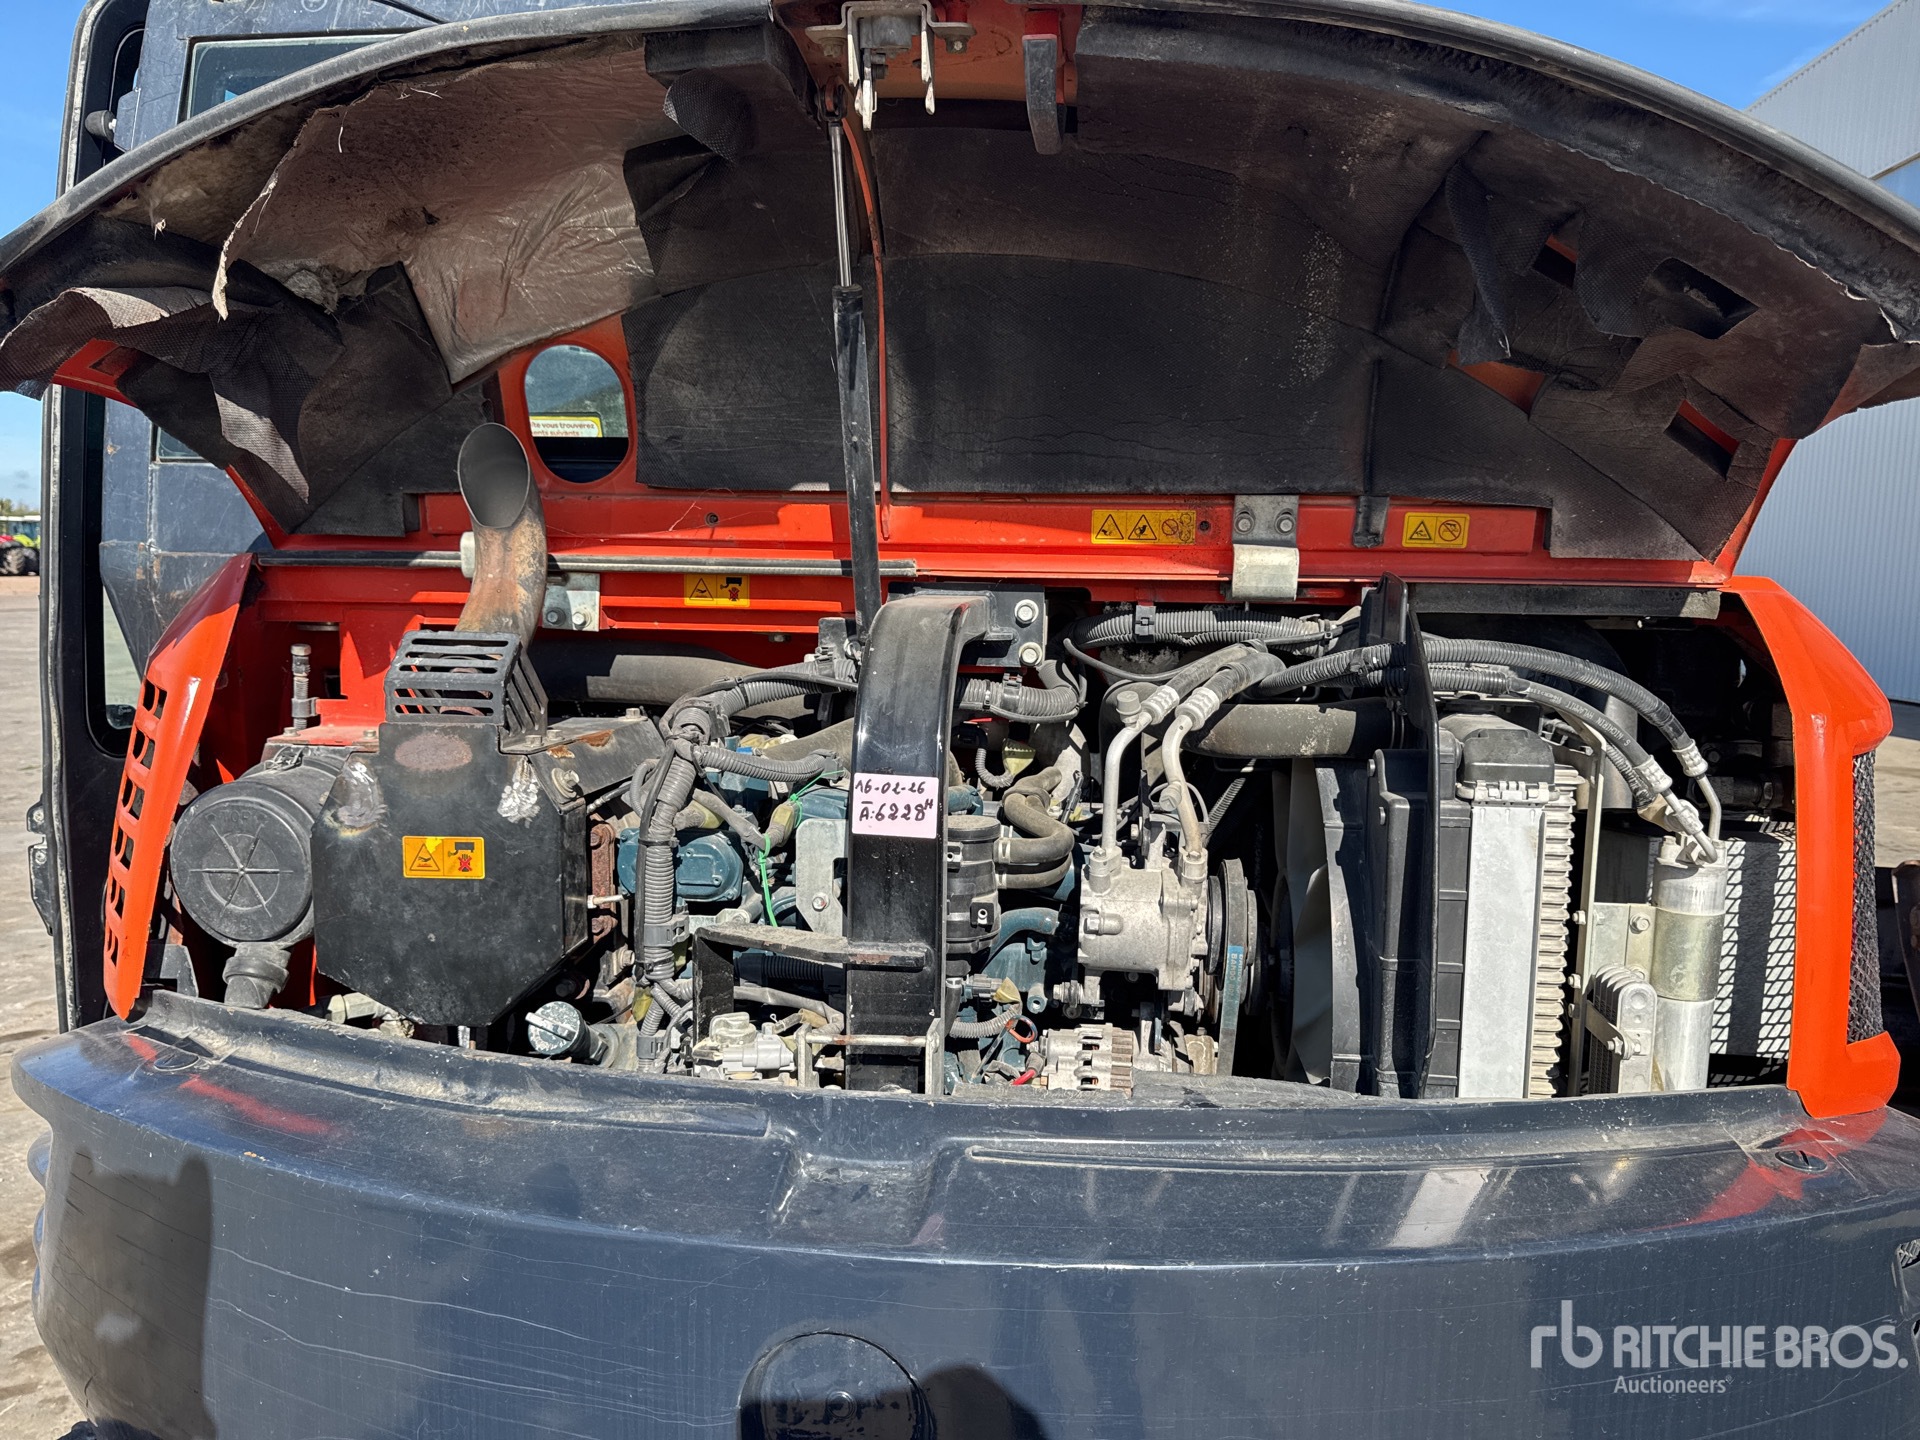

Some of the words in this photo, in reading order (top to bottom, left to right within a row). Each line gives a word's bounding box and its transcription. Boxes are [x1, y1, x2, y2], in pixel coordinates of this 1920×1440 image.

[560, 421, 594, 429] trouverez
[855, 779, 926, 794] 16-02-26
[1229, 953, 1237, 981] BANDO
